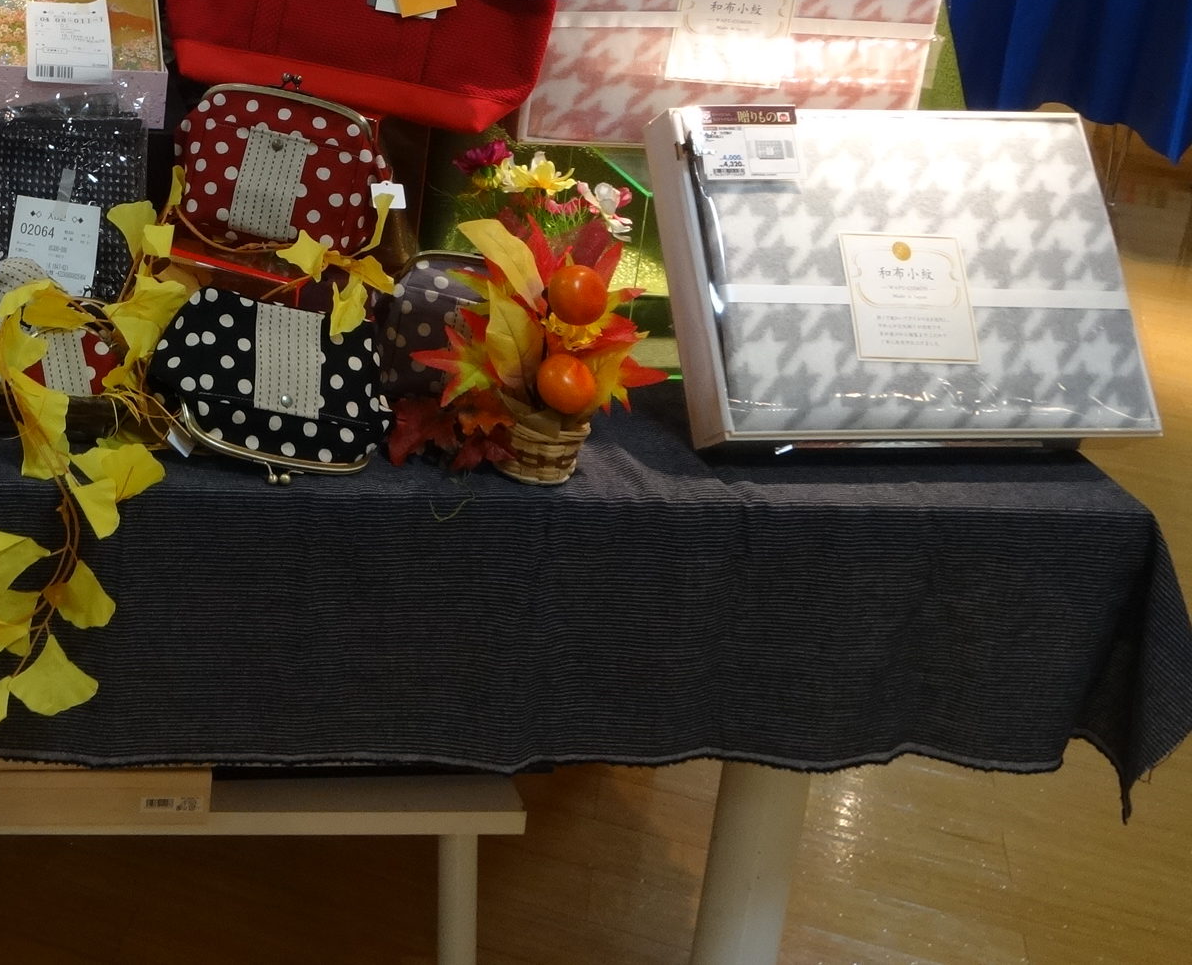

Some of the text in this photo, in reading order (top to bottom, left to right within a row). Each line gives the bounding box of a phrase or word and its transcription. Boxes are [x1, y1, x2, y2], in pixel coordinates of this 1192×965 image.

[710, 0, 763, 16] 和布小紋
[737, 110, 777, 123] 贈りもの
[20, 222, 55, 239] 02064
[878, 266, 935, 281] 和布小紋
